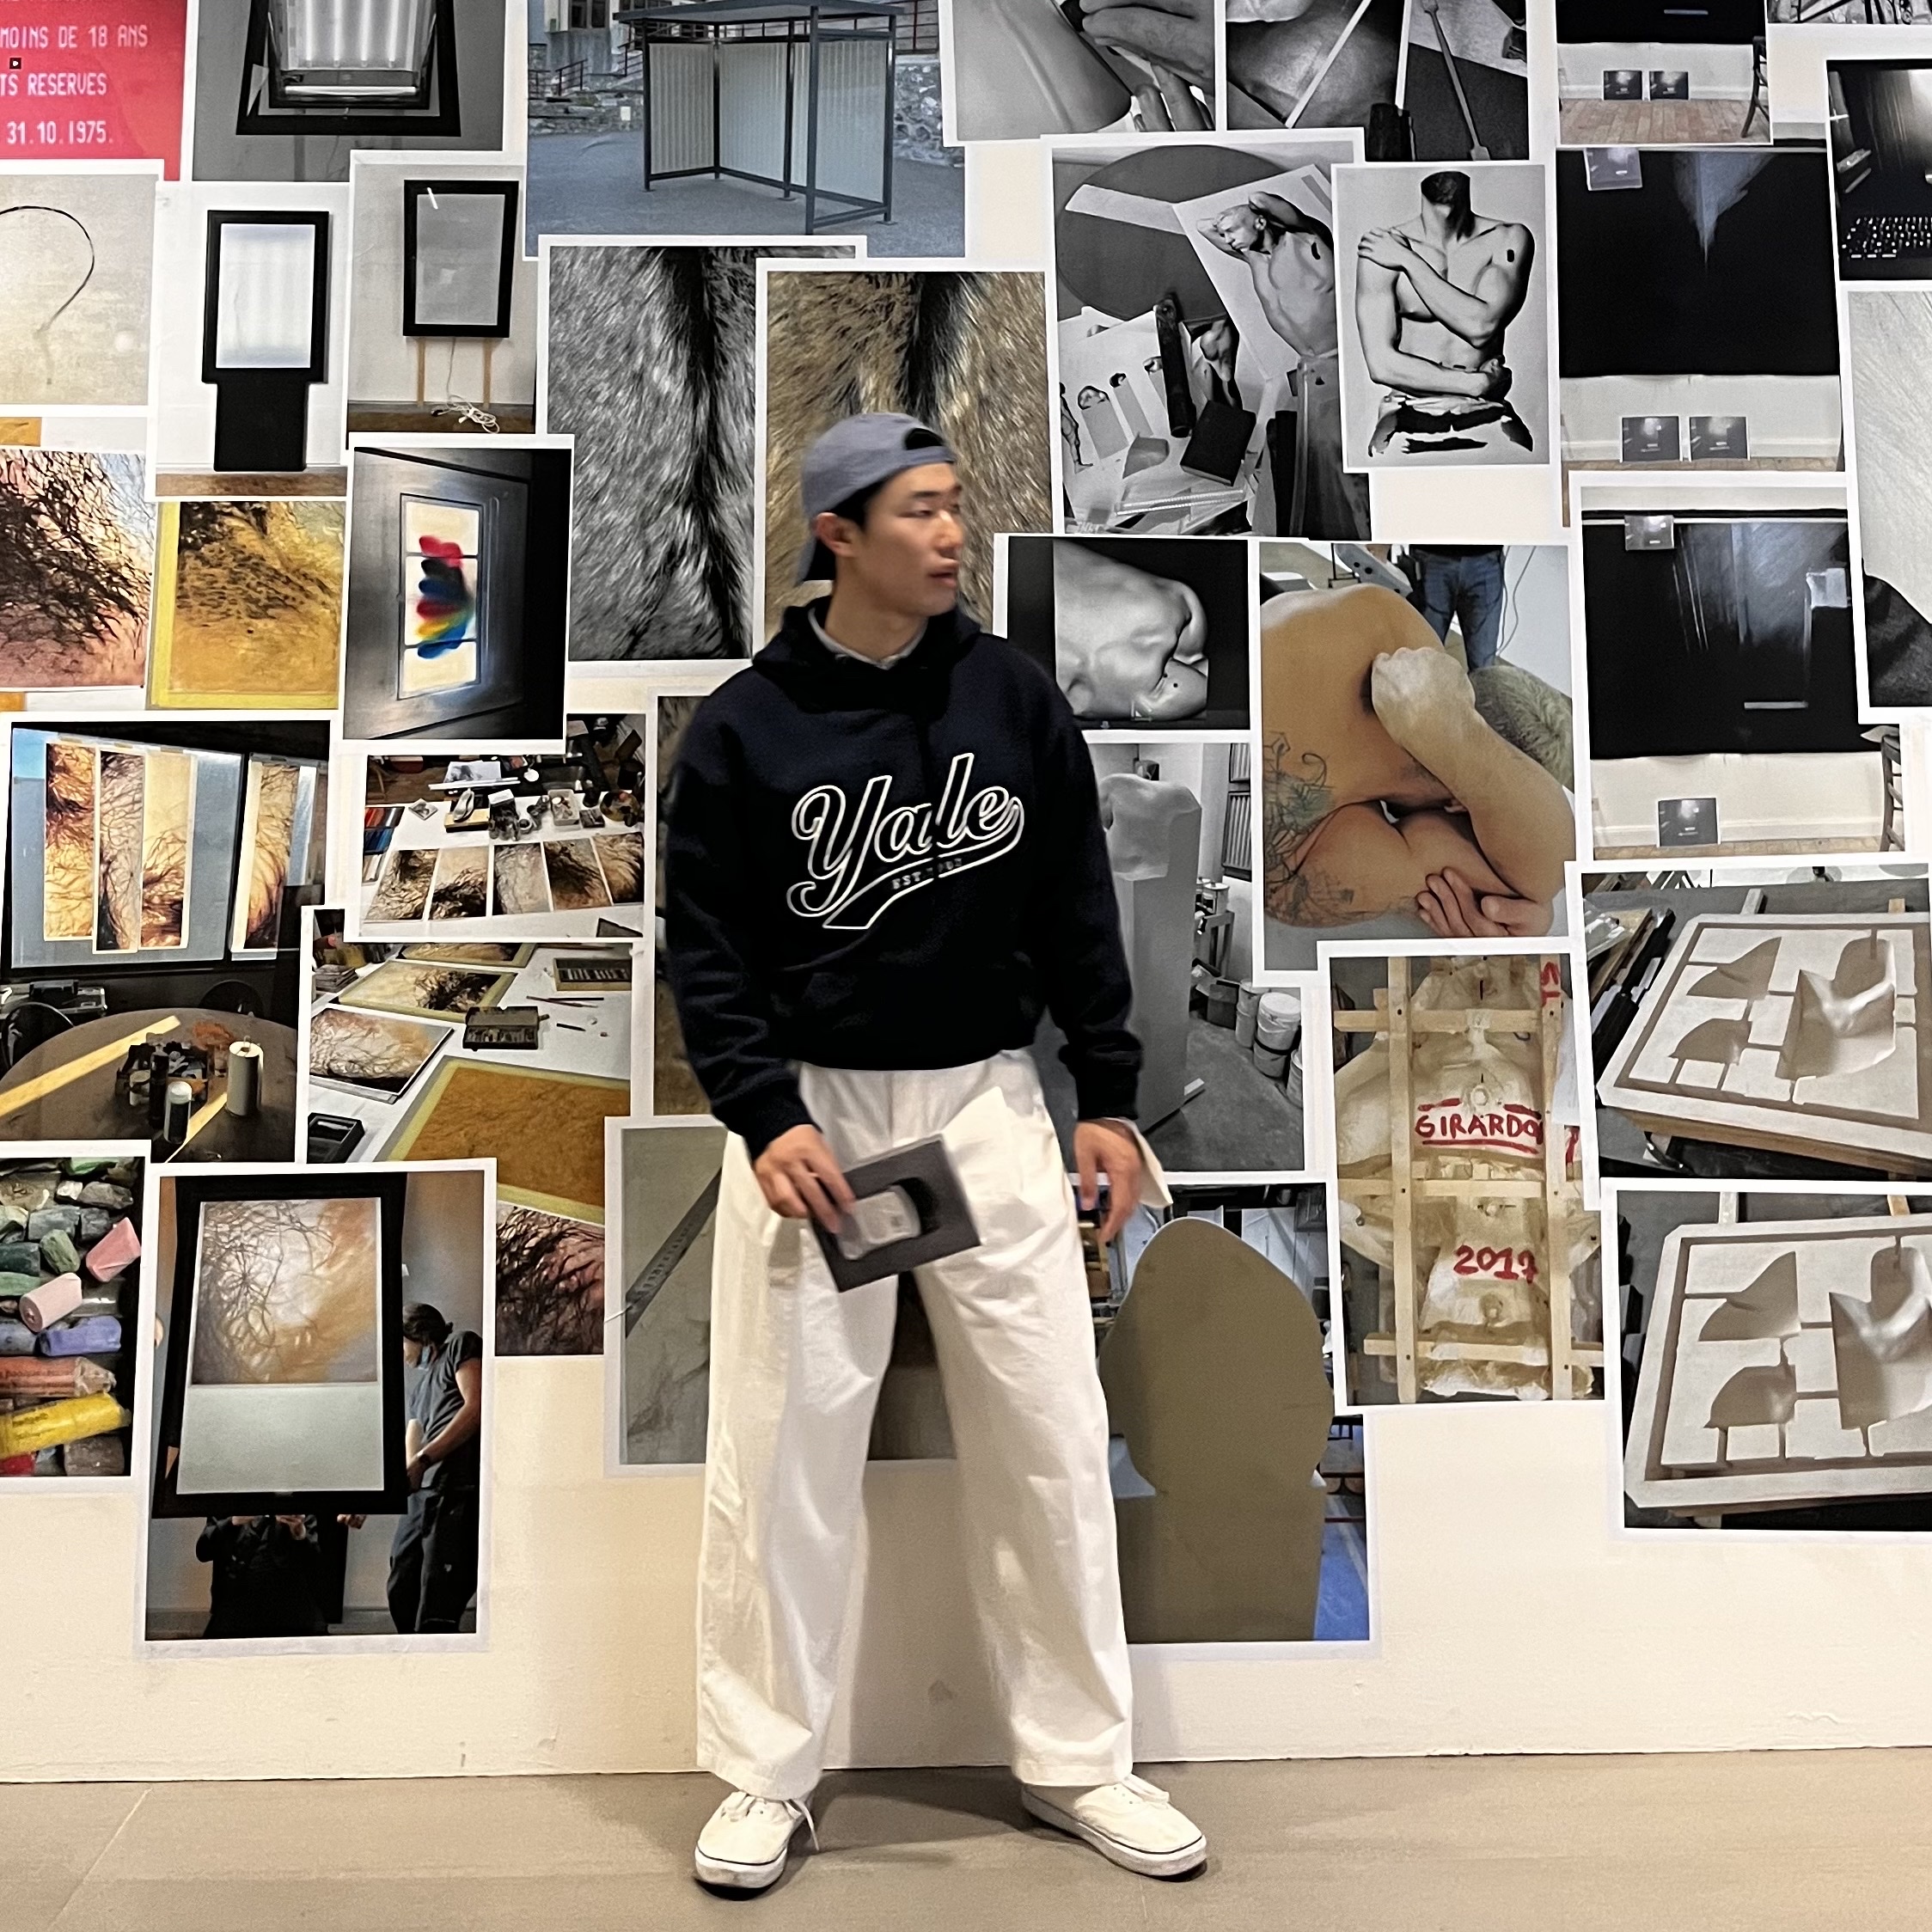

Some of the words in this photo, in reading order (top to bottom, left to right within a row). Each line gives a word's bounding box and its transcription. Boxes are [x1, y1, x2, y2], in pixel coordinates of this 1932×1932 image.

[0, 26, 48, 48] MOINS
[58, 26, 77, 48] DE
[89, 25, 108, 47] 18
[117, 25, 148, 47] ANS
[28, 72, 107, 95] RESERVES
[7, 121, 113, 144] 31.10.1975.
[786, 753, 1024, 928] Yale
